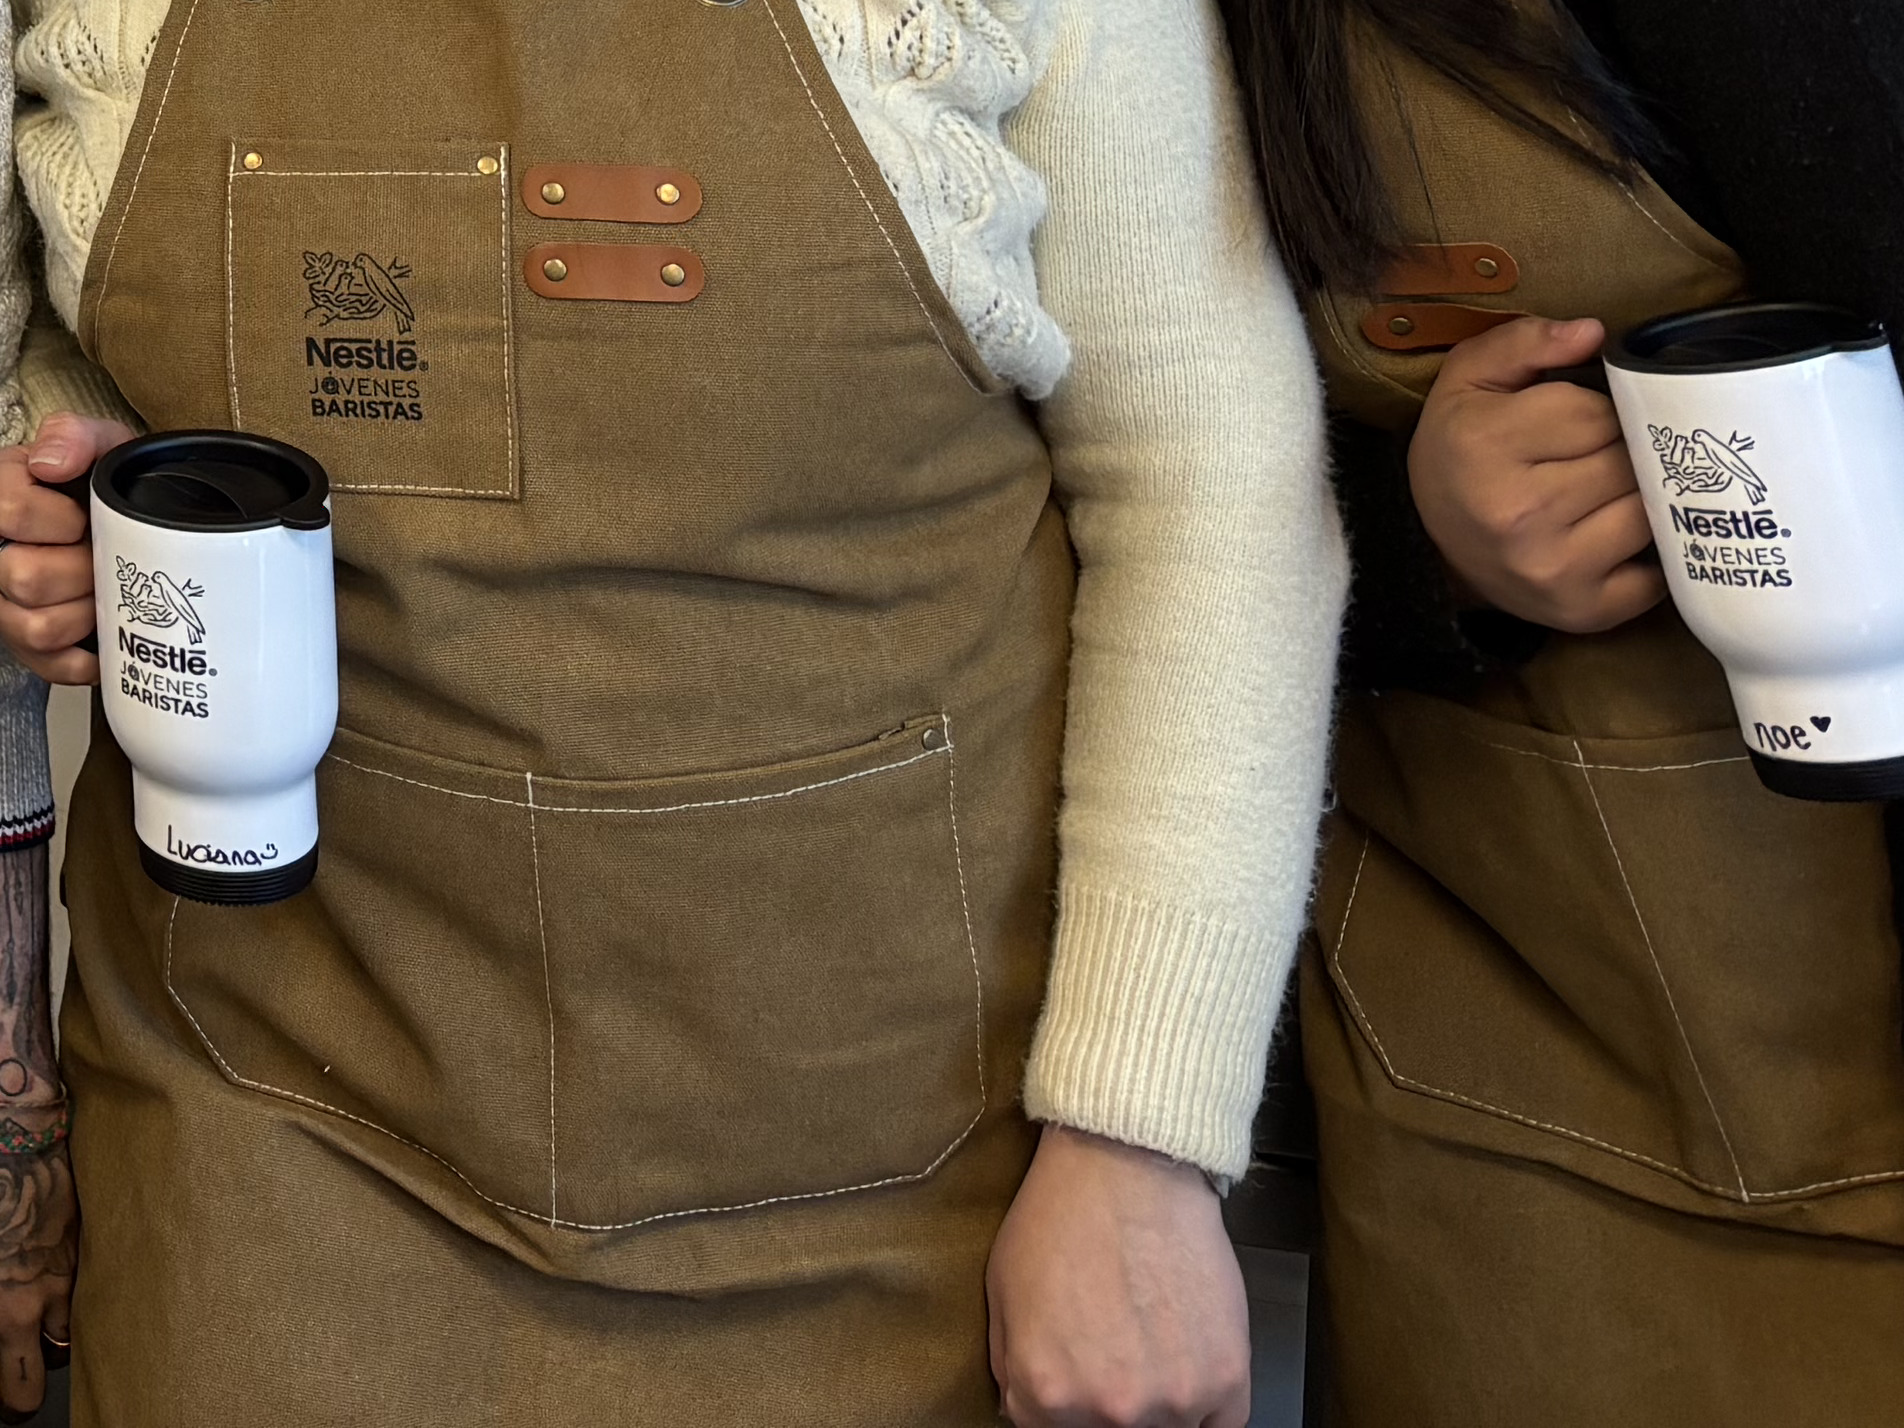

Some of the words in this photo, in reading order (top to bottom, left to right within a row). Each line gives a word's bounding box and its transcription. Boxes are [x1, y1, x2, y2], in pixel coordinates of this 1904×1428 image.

[305, 336, 418, 372] Nestlé
[309, 371, 421, 399] JÓVENES
[311, 398, 424, 421] BARISTAS
[1669, 503, 1779, 540] Nestlé
[1682, 538, 1787, 566] JÓVENES
[1685, 561, 1793, 588] BARISTAS
[118, 625, 208, 677] Nestlé
[120, 660, 209, 700] JÓVENES
[121, 677, 210, 719] BARISTAS
[1753, 722, 1812, 752] noe
[167, 824, 263, 867] Luciana
